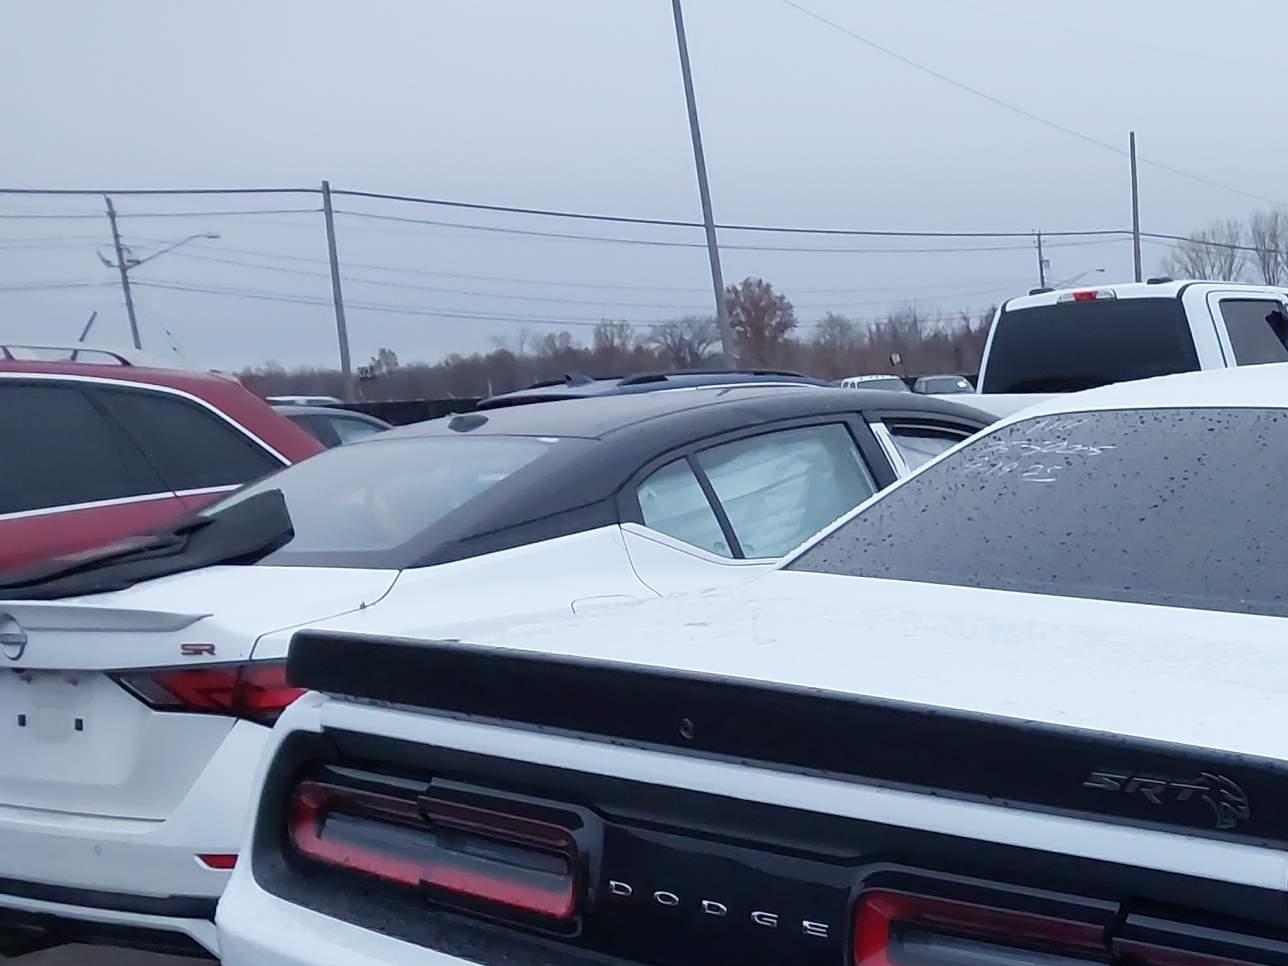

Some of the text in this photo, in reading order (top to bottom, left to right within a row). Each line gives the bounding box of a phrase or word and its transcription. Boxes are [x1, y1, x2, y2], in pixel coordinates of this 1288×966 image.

[181, 643, 216, 656] SR
[1083, 771, 1210, 805] SRT
[609, 880, 829, 938] DODGE
